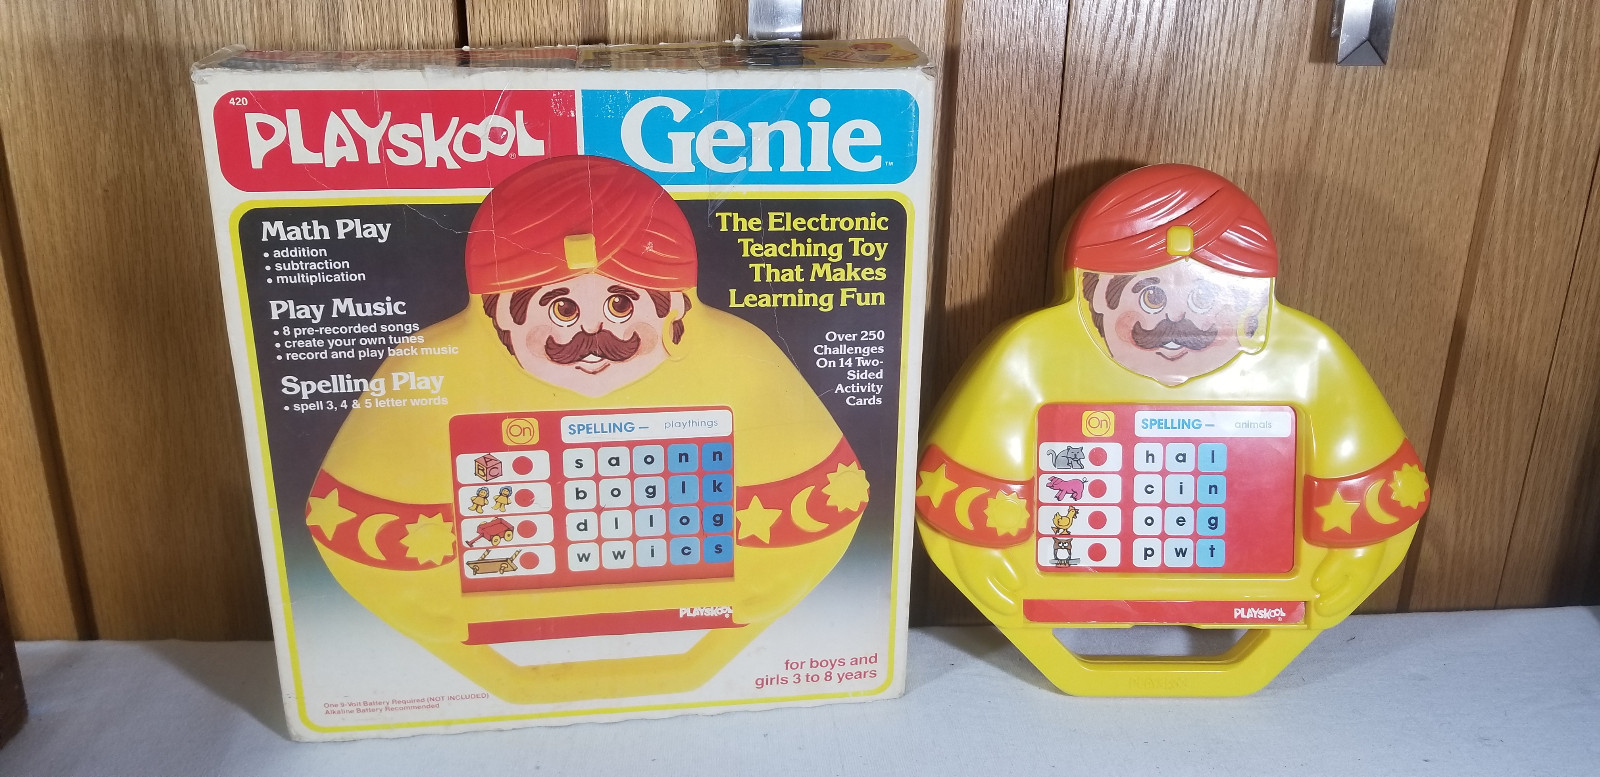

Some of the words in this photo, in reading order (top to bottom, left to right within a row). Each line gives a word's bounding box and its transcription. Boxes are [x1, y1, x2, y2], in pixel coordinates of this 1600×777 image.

[229, 97, 248, 106] 420
[245, 109, 545, 169] PLAYSKOOL
[621, 96, 882, 173] Genie
[716, 212, 762, 231] The
[768, 212, 889, 231] Electronic
[262, 220, 330, 241] Math
[336, 219, 391, 242] Play
[273, 248, 327, 258] addition
[738, 238, 843, 262] Teaching
[849, 238, 888, 261] Toy
[275, 260, 350, 271] subtraction
[749, 263, 804, 282] That
[810, 263, 886, 281] Makes
[277, 273, 366, 285] multiplication
[729, 289, 834, 312] Learning
[840, 288, 885, 306] Fun
[269, 300, 325, 323] Play
[332, 296, 407, 317] Music
[283, 327, 291, 336] 8
[294, 323, 377, 338] pre-recorded
[381, 322, 419, 333] songs
[825, 331, 857, 341] Over
[861, 331, 885, 340] 250
[285, 338, 324, 348] create
[328, 337, 356, 349] your
[360, 337, 386, 345] own
[389, 335, 424, 344] tunes
[286, 351, 328, 360] record
[331, 349, 355, 359] and
[359, 348, 384, 360] play
[388, 346, 418, 356] back
[421, 346, 459, 355] music
[814, 345, 884, 356] Challenges
[816, 358, 836, 368] On
[839, 358, 852, 367] 14
[855, 357, 883, 367] Two-
[847, 370, 883, 380] Sided
[281, 374, 386, 399] Spelling
[392, 372, 444, 393] Play
[835, 383, 883, 396] Activity
[294, 401, 323, 413] spell
[327, 401, 338, 411] 3,
[341, 400, 348, 409] 4
[352, 400, 361, 408] &
[365, 399, 372, 408] 5
[376, 398, 407, 408] letter
[410, 396, 448, 406] words
[846, 396, 882, 406] Cards
[568, 422, 635, 435] SPELLING
[664, 419, 718, 430] playthings
[1088, 417, 1108, 428] On
[1141, 418, 1202, 430] SPELLING
[1234, 420, 1272, 429] animals
[509, 425, 532, 437] On
[575, 458, 584, 469] s
[608, 456, 620, 467] a
[643, 454, 655, 465] o
[679, 452, 688, 462] n
[712, 450, 722, 461] n
[1146, 451, 1155, 463] h
[1176, 452, 1186, 462] a
[575, 488, 587, 500] b
[610, 487, 622, 498] o
[645, 485, 656, 499] g
[713, 480, 722, 492] k
[1144, 484, 1154, 494] c
[1179, 482, 1183, 494] i
[1209, 484, 1218, 494] n
[577, 519, 587, 532] d
[679, 515, 690, 526] o
[713, 512, 723, 526] g
[1144, 516, 1154, 526] o
[1176, 516, 1186, 526] e
[1208, 516, 1218, 529] g
[577, 552, 591, 563] w
[612, 549, 626, 560] w
[651, 546, 654, 558] i
[681, 545, 691, 556] c
[714, 543, 722, 554] s
[1144, 547, 1155, 560] p
[1175, 547, 1187, 557] w
[1209, 545, 1215, 557] t
[680, 606, 733, 618] PLAYSKOOL
[1234, 608, 1286, 619] PLAYSKOOL
[784, 659, 806, 670] for
[810, 657, 846, 670] boys
[850, 653, 878, 666] and
[755, 675, 788, 689] girls
[792, 674, 801, 684] 3
[805, 672, 820, 683] to
[824, 671, 832, 681] 8
[836, 669, 877, 683] years
[385, 703, 440, 711] Recommended
